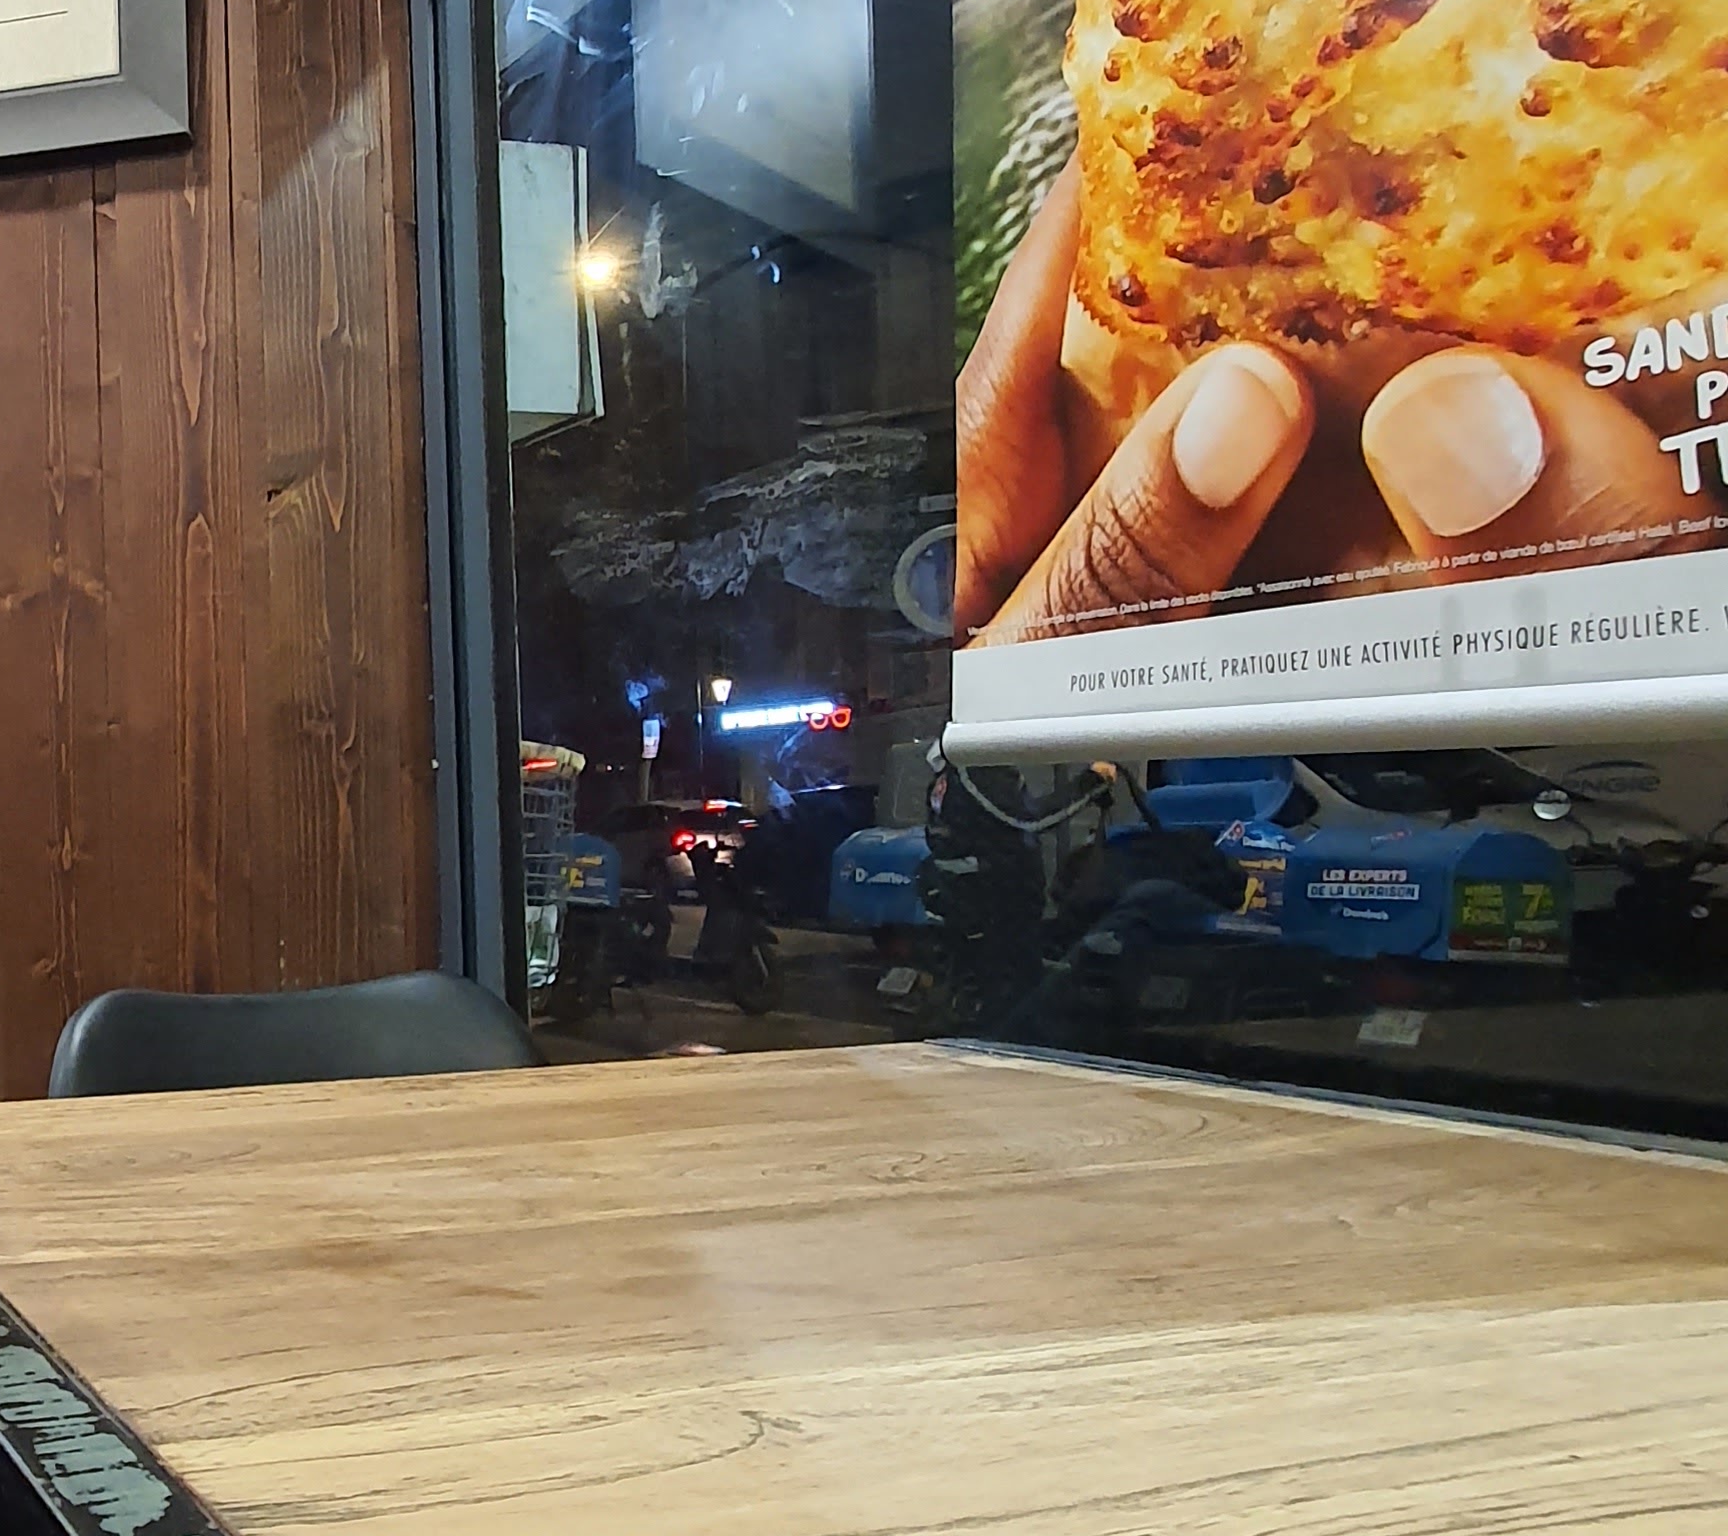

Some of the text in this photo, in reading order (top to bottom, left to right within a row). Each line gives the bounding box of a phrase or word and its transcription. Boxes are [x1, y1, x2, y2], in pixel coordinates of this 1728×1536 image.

[1070, 672, 1105, 693] POUR
[1111, 666, 1154, 689] VOTRE
[1162, 656, 1213, 684] SANTÉ,
[1221, 650, 1309, 678] PRATIQUEZ
[1318, 644, 1352, 669] UNE
[1360, 630, 1442, 664] ACTIVITÉ
[1453, 622, 1559, 656] PHYSIQUE
[1570, 604, 1710, 645] RÉGULIÈRE.
[1310, 885, 1416, 898] DE LA LIVRAISON
